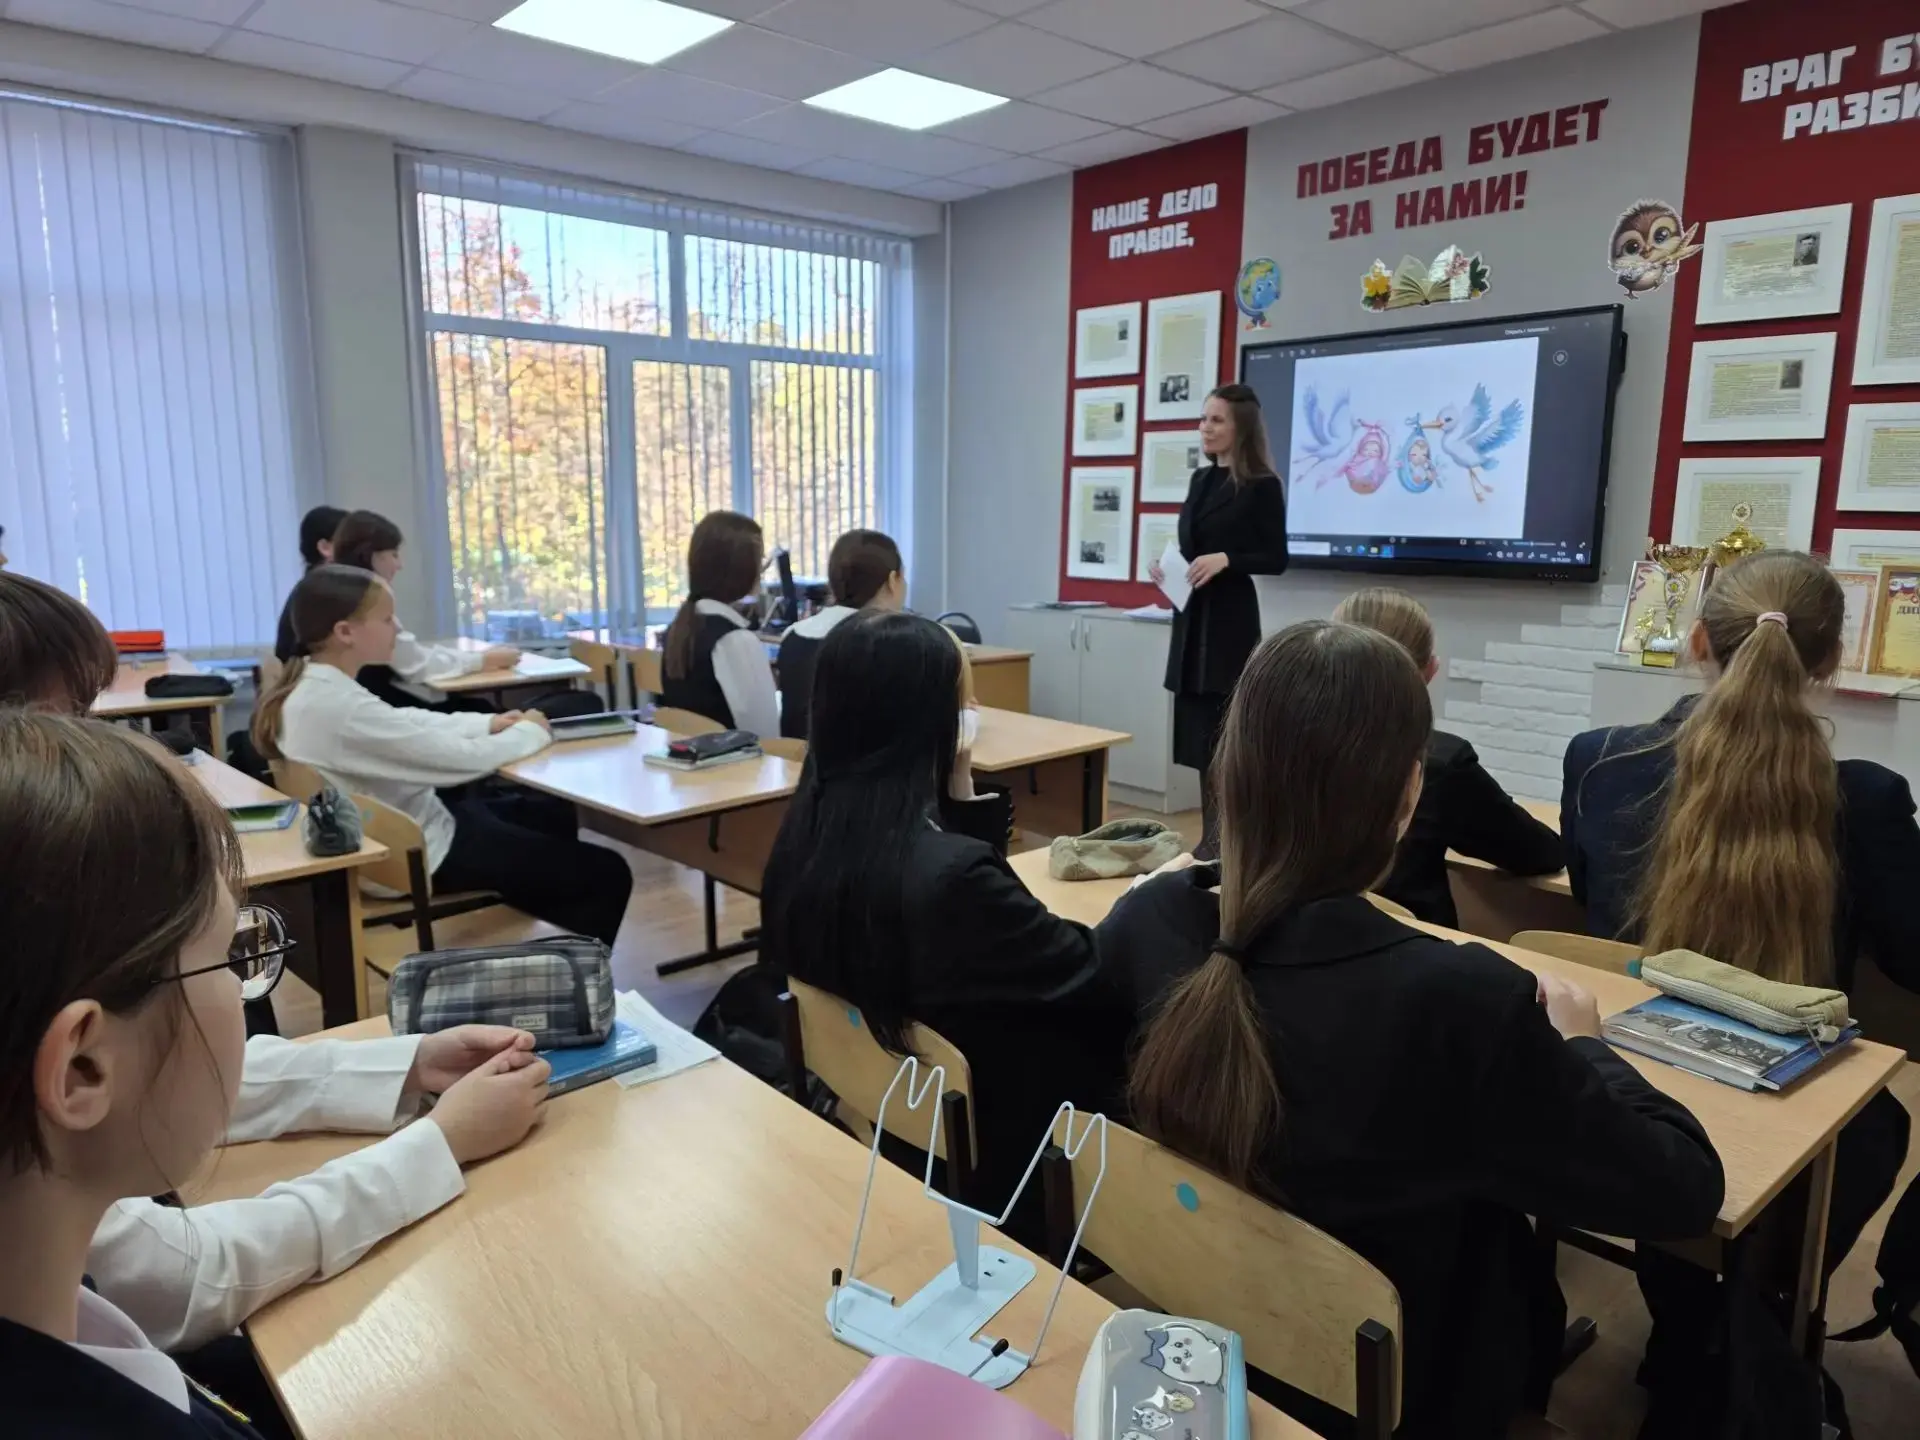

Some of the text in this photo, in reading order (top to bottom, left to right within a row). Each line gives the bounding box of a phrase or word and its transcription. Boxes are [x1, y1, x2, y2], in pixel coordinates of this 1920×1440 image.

[1741, 32, 1920, 102] ВРАГ Б
[1297, 97, 1610, 199] ПОБЕДА БУДЕТ
[1091, 182, 1217, 232] НАШЕ ДЕЛО
[1108, 221, 1194, 259] ПРАВОЕ,
[1328, 170, 1528, 240] ЗА НАМИ!
